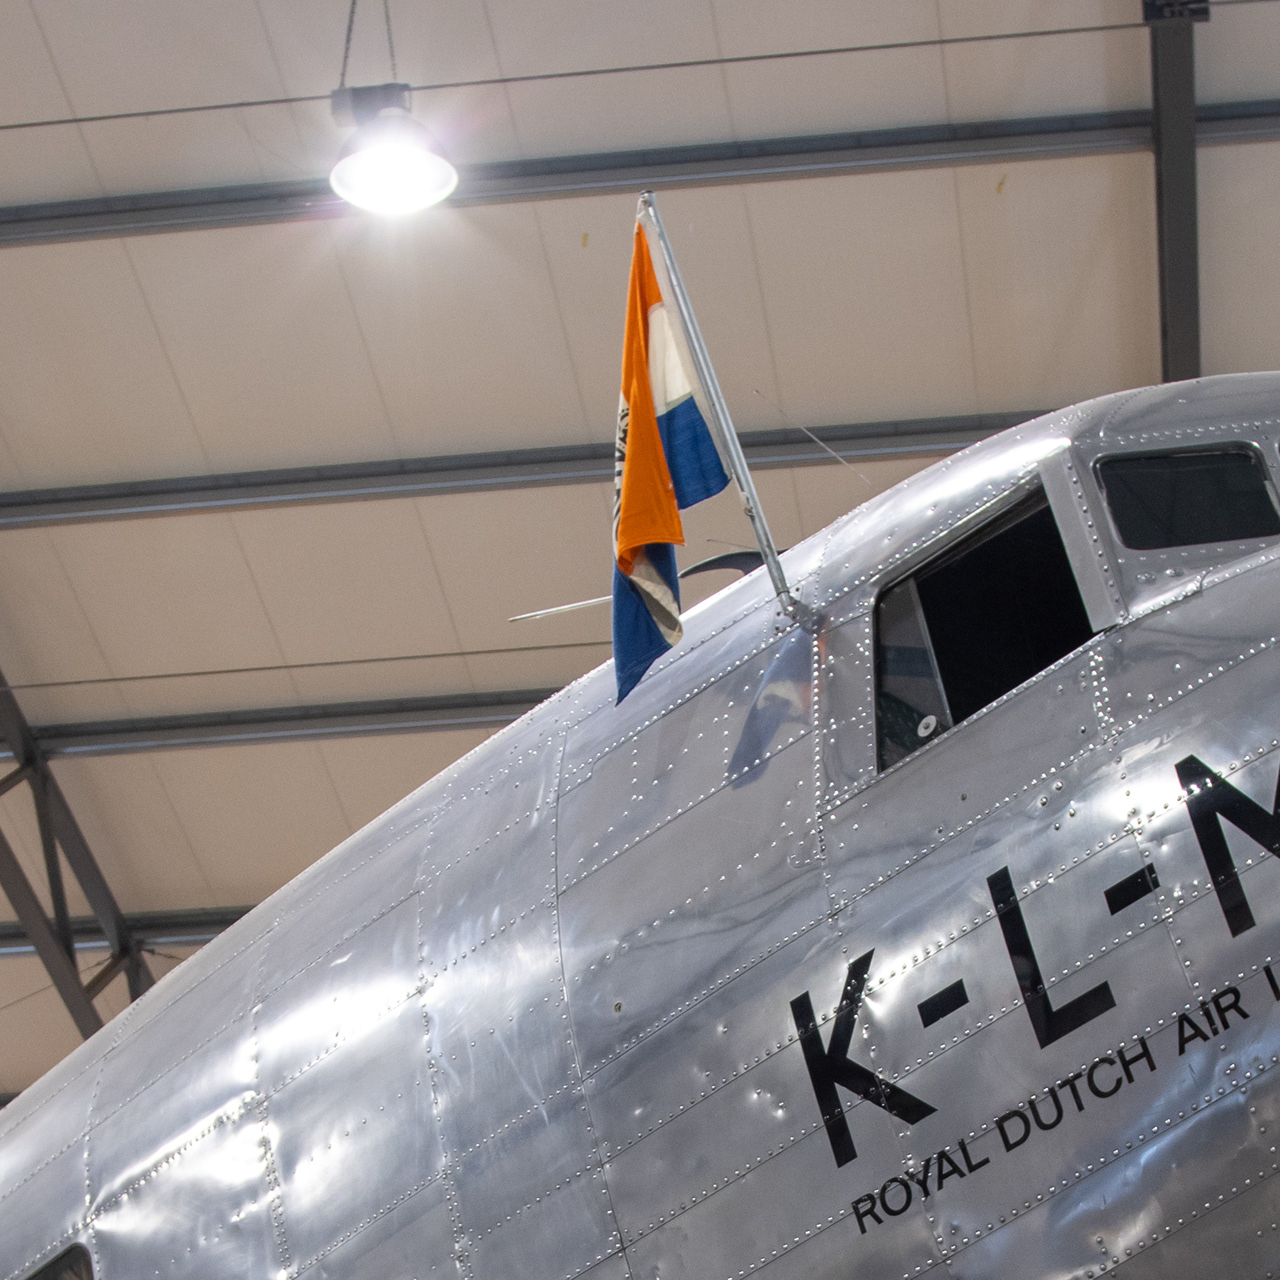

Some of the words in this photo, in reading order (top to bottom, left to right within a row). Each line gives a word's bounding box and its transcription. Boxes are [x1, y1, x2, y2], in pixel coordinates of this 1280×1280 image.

[851, 1138, 990, 1235] ROYAL
[995, 1036, 1157, 1154] DUTCH
[1175, 985, 1250, 1057] AIR
